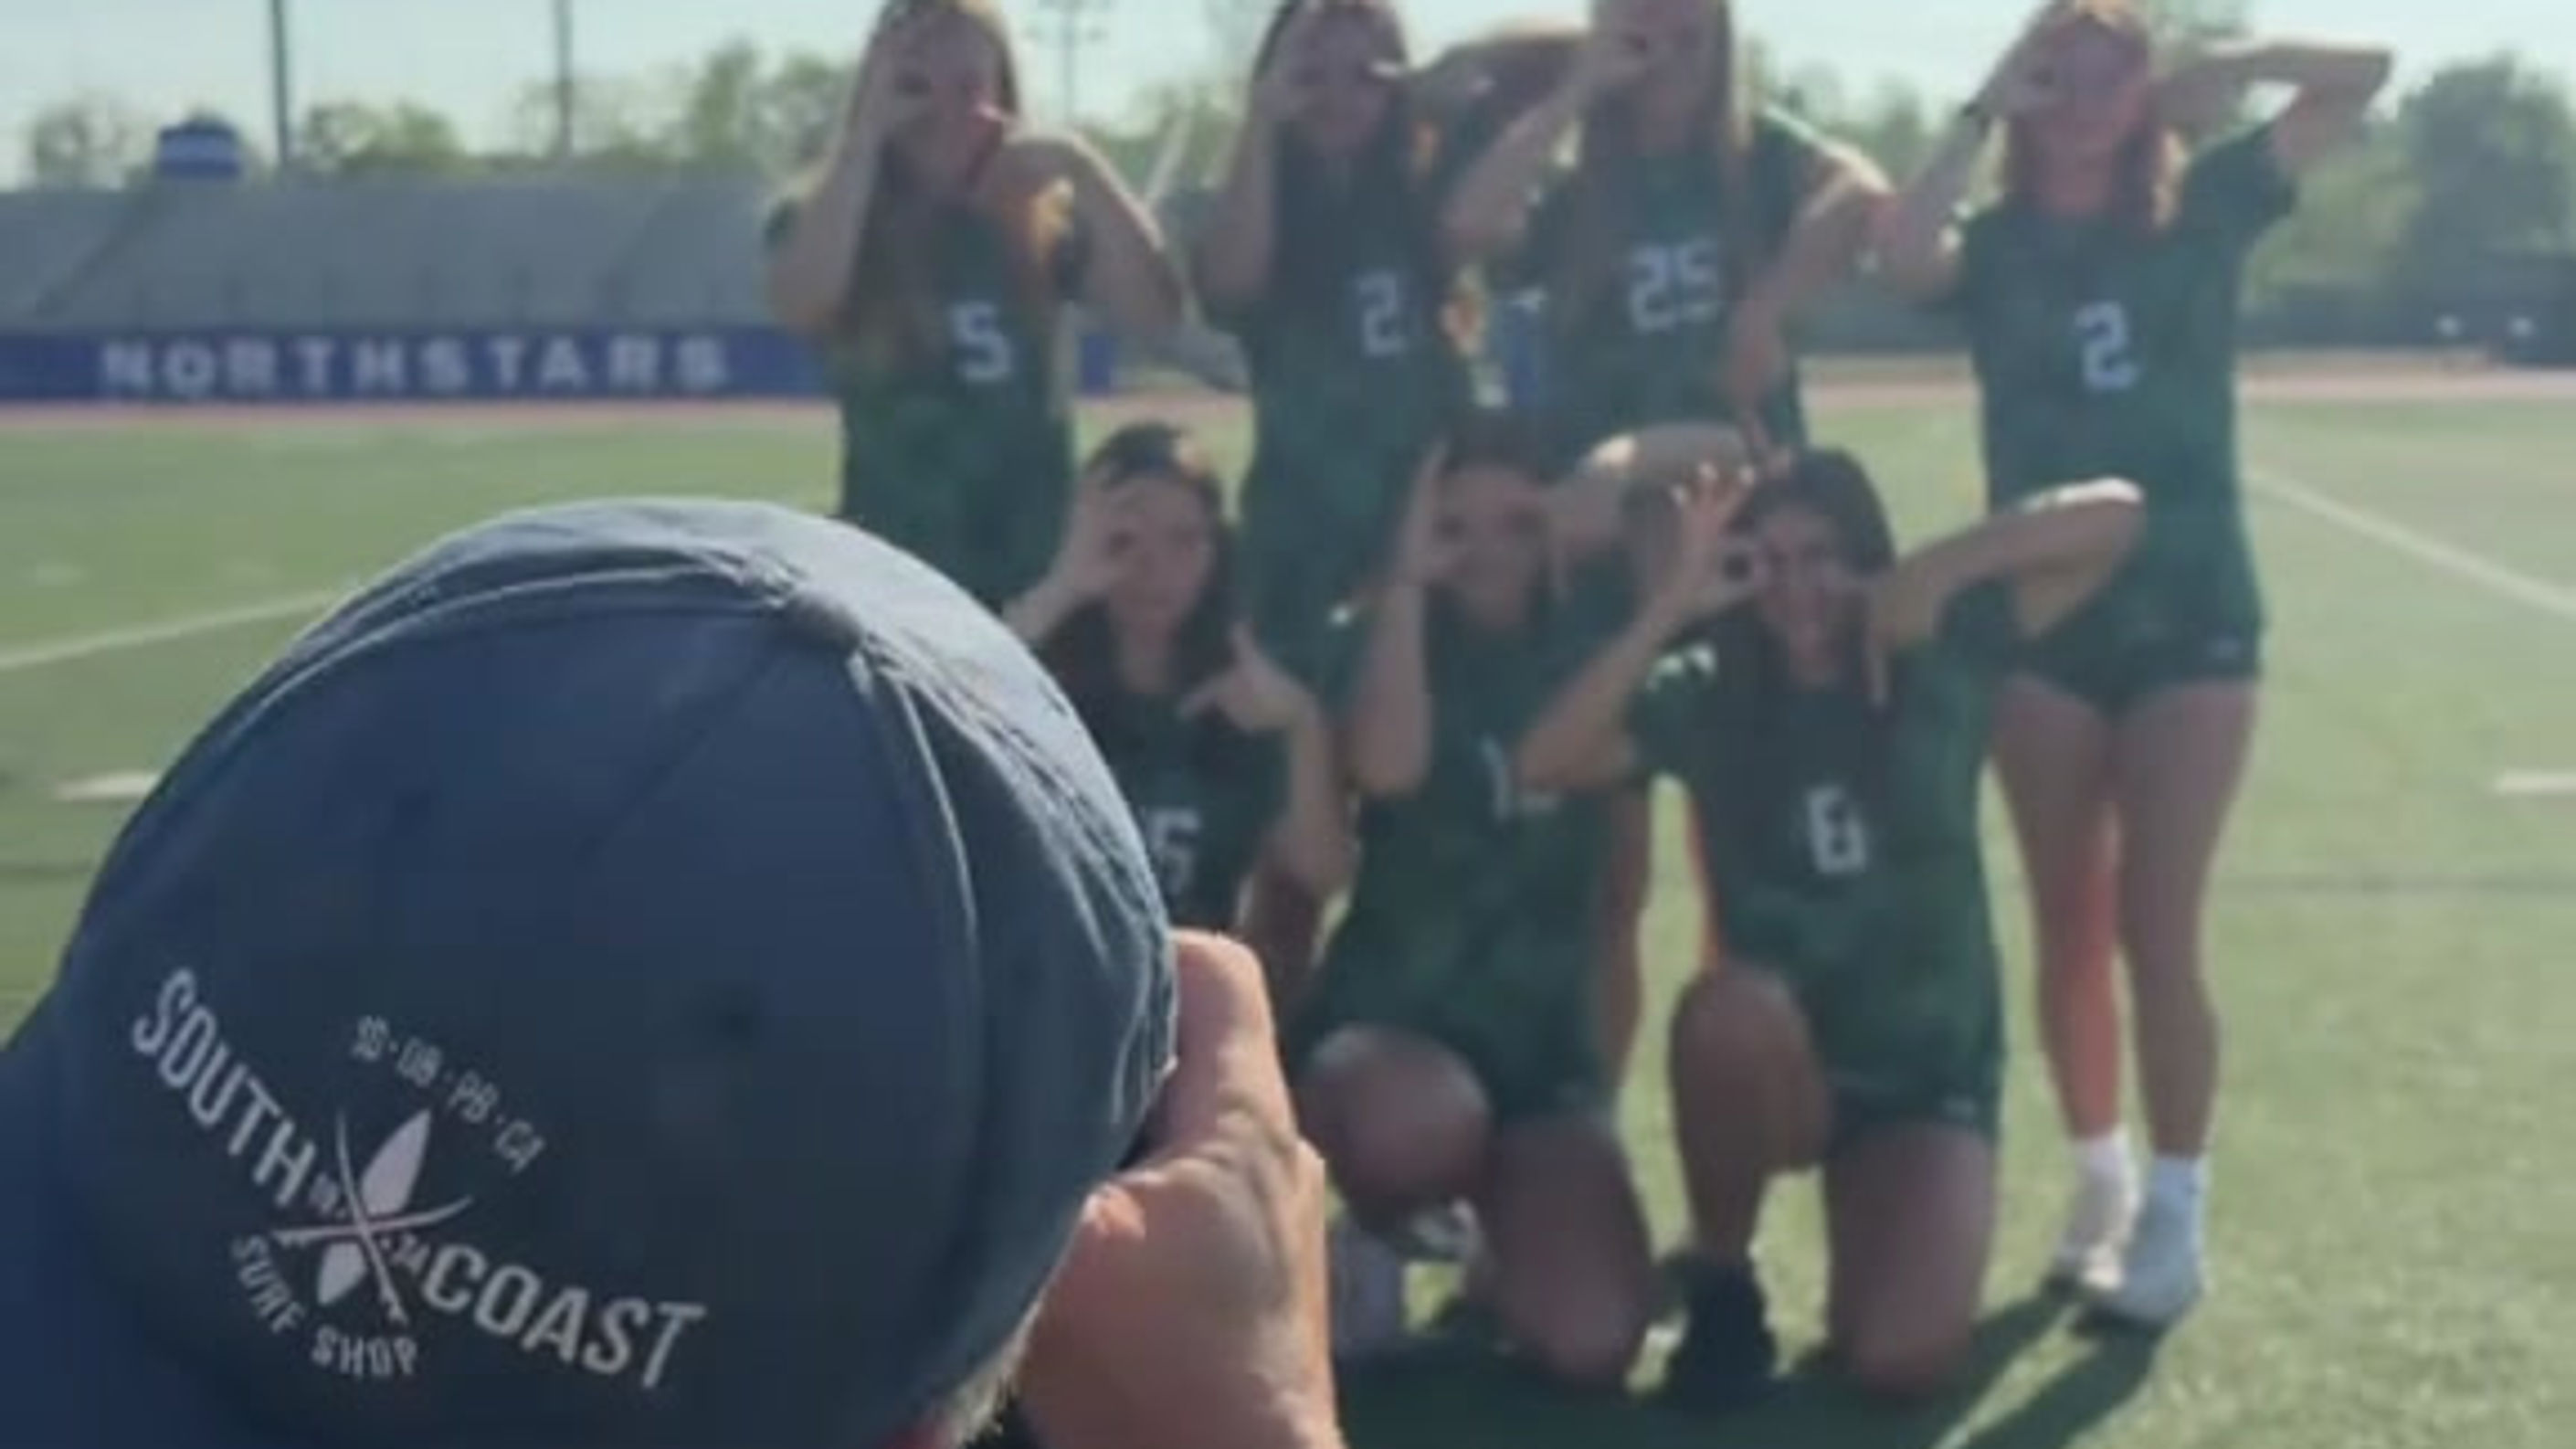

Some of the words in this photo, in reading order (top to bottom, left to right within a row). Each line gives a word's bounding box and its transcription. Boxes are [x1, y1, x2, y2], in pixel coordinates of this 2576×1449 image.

[1629, 238, 1721, 332] 25
[102, 335, 729, 398] NORTHSTARS
[951, 301, 1013, 383] 5
[2074, 301, 2138, 390] 2
[132, 968, 316, 1206] SOUTH
[420, 1243, 706, 1389] COAST
[231, 1235, 305, 1333] SURF
[311, 1326, 417, 1376] SHOP
